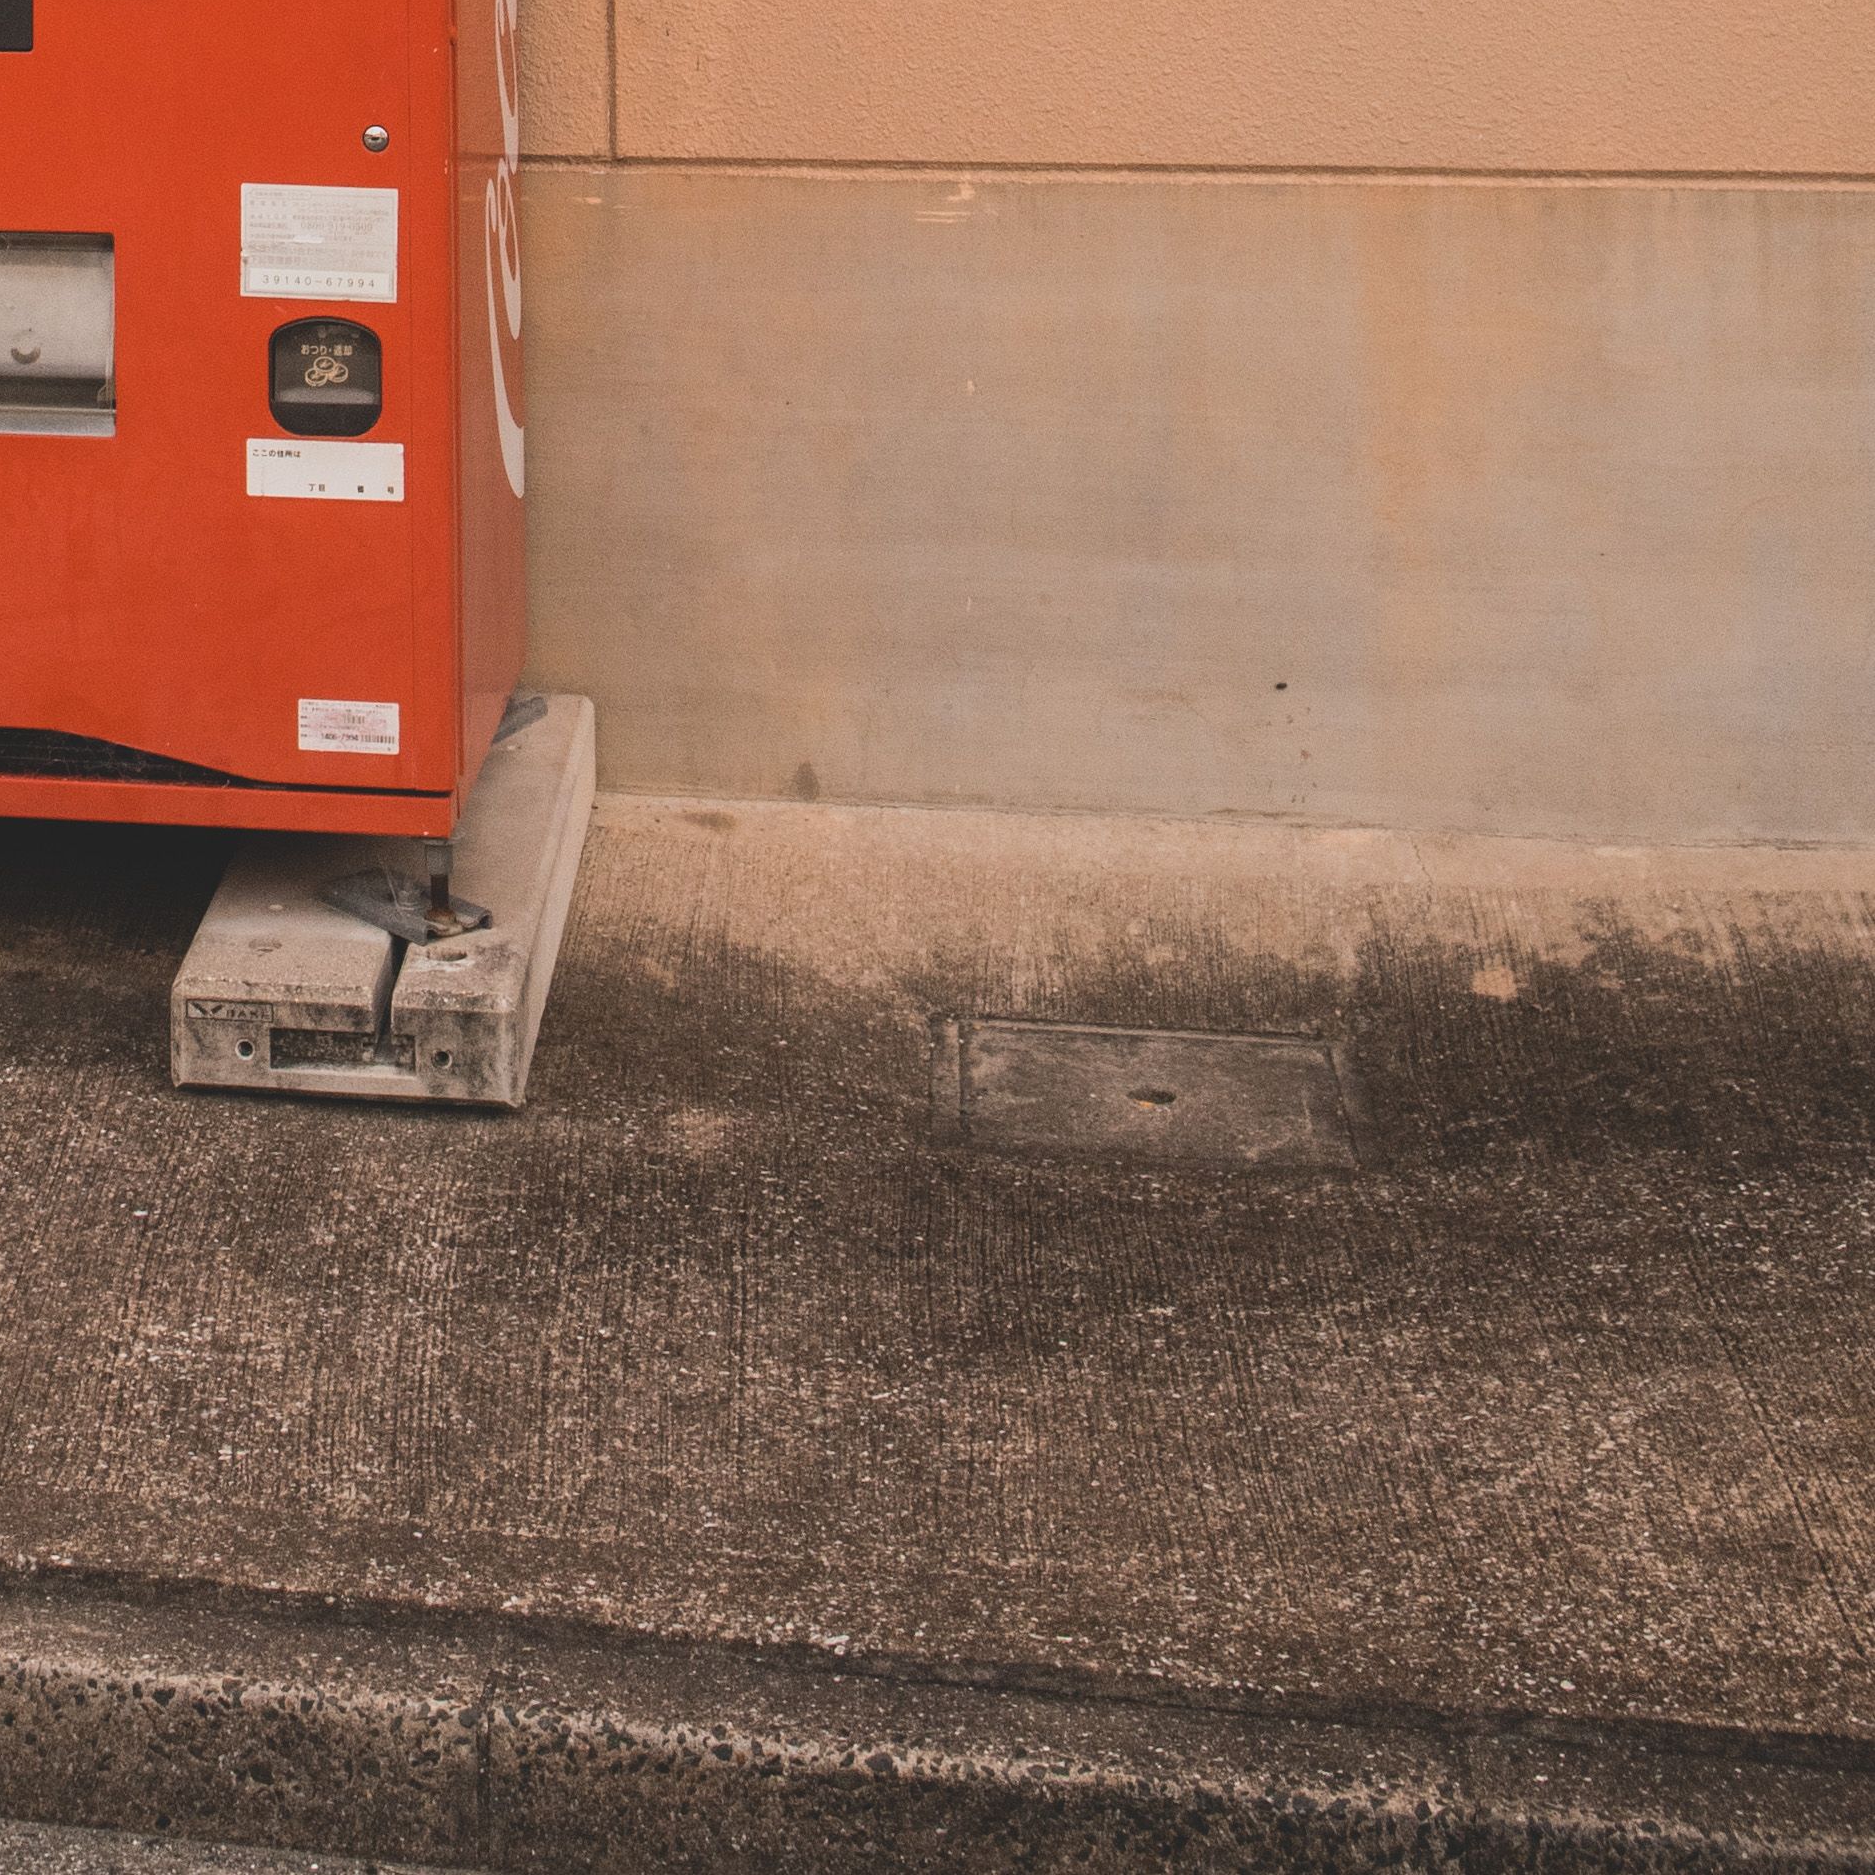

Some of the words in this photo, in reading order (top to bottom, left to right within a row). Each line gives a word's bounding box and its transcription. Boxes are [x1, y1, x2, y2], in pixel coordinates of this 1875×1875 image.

[261, 274, 375, 289] 39140-67994
[252, 449, 301, 458] ここの住所は
